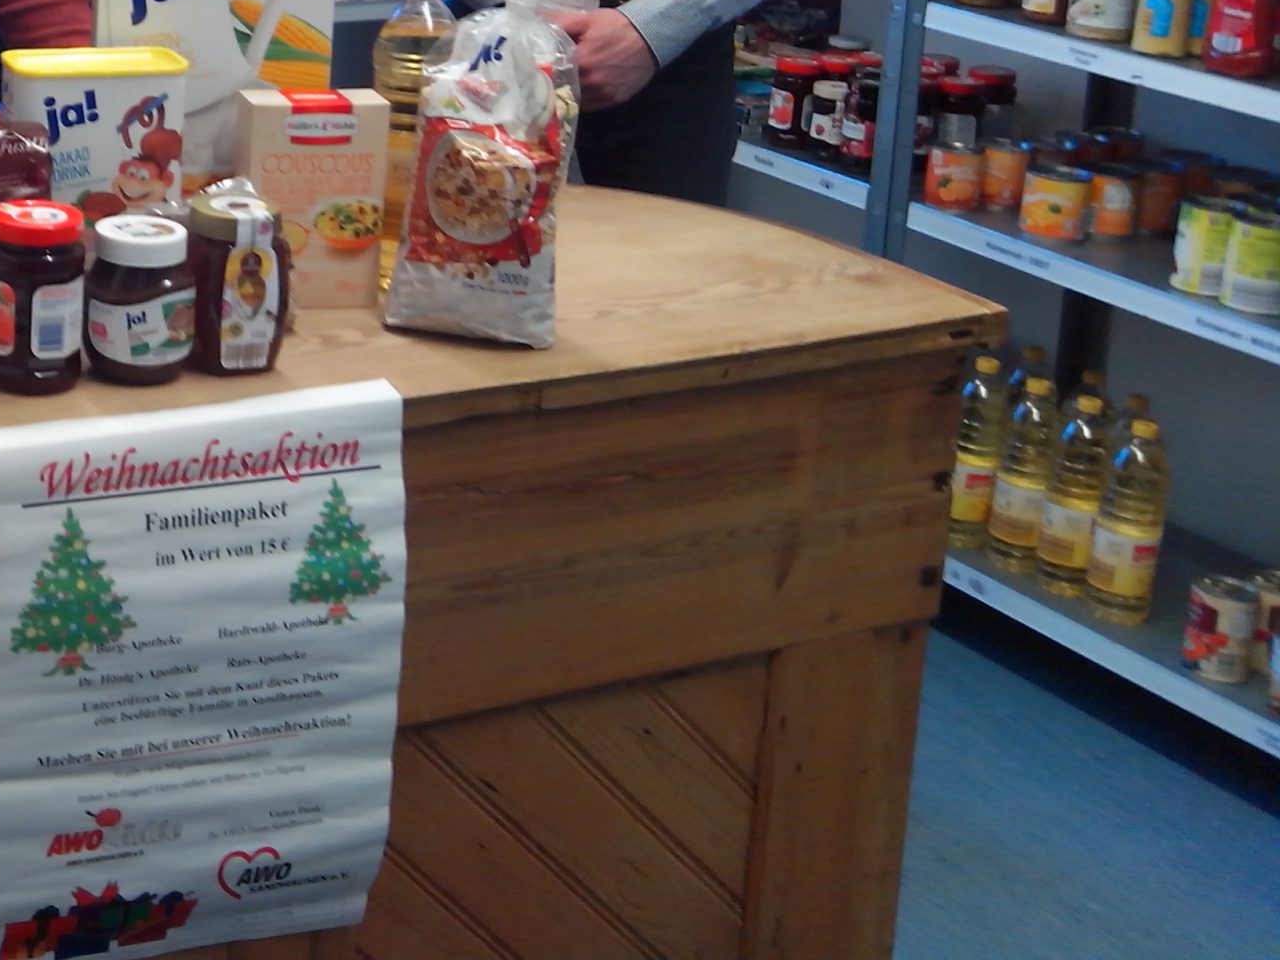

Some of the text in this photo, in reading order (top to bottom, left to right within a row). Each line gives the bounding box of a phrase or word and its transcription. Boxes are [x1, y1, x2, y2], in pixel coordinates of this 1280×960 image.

[43, 89, 100, 147] ja!
[39, 431, 361, 500] Weihnachtsaktion
[144, 499, 289, 533] Familienpaket
[154, 537, 292, 568] im Wert von 15 €
[121, 743, 144, 757] mit
[46, 828, 104, 858] AWO
[236, 862, 293, 887] AWO
